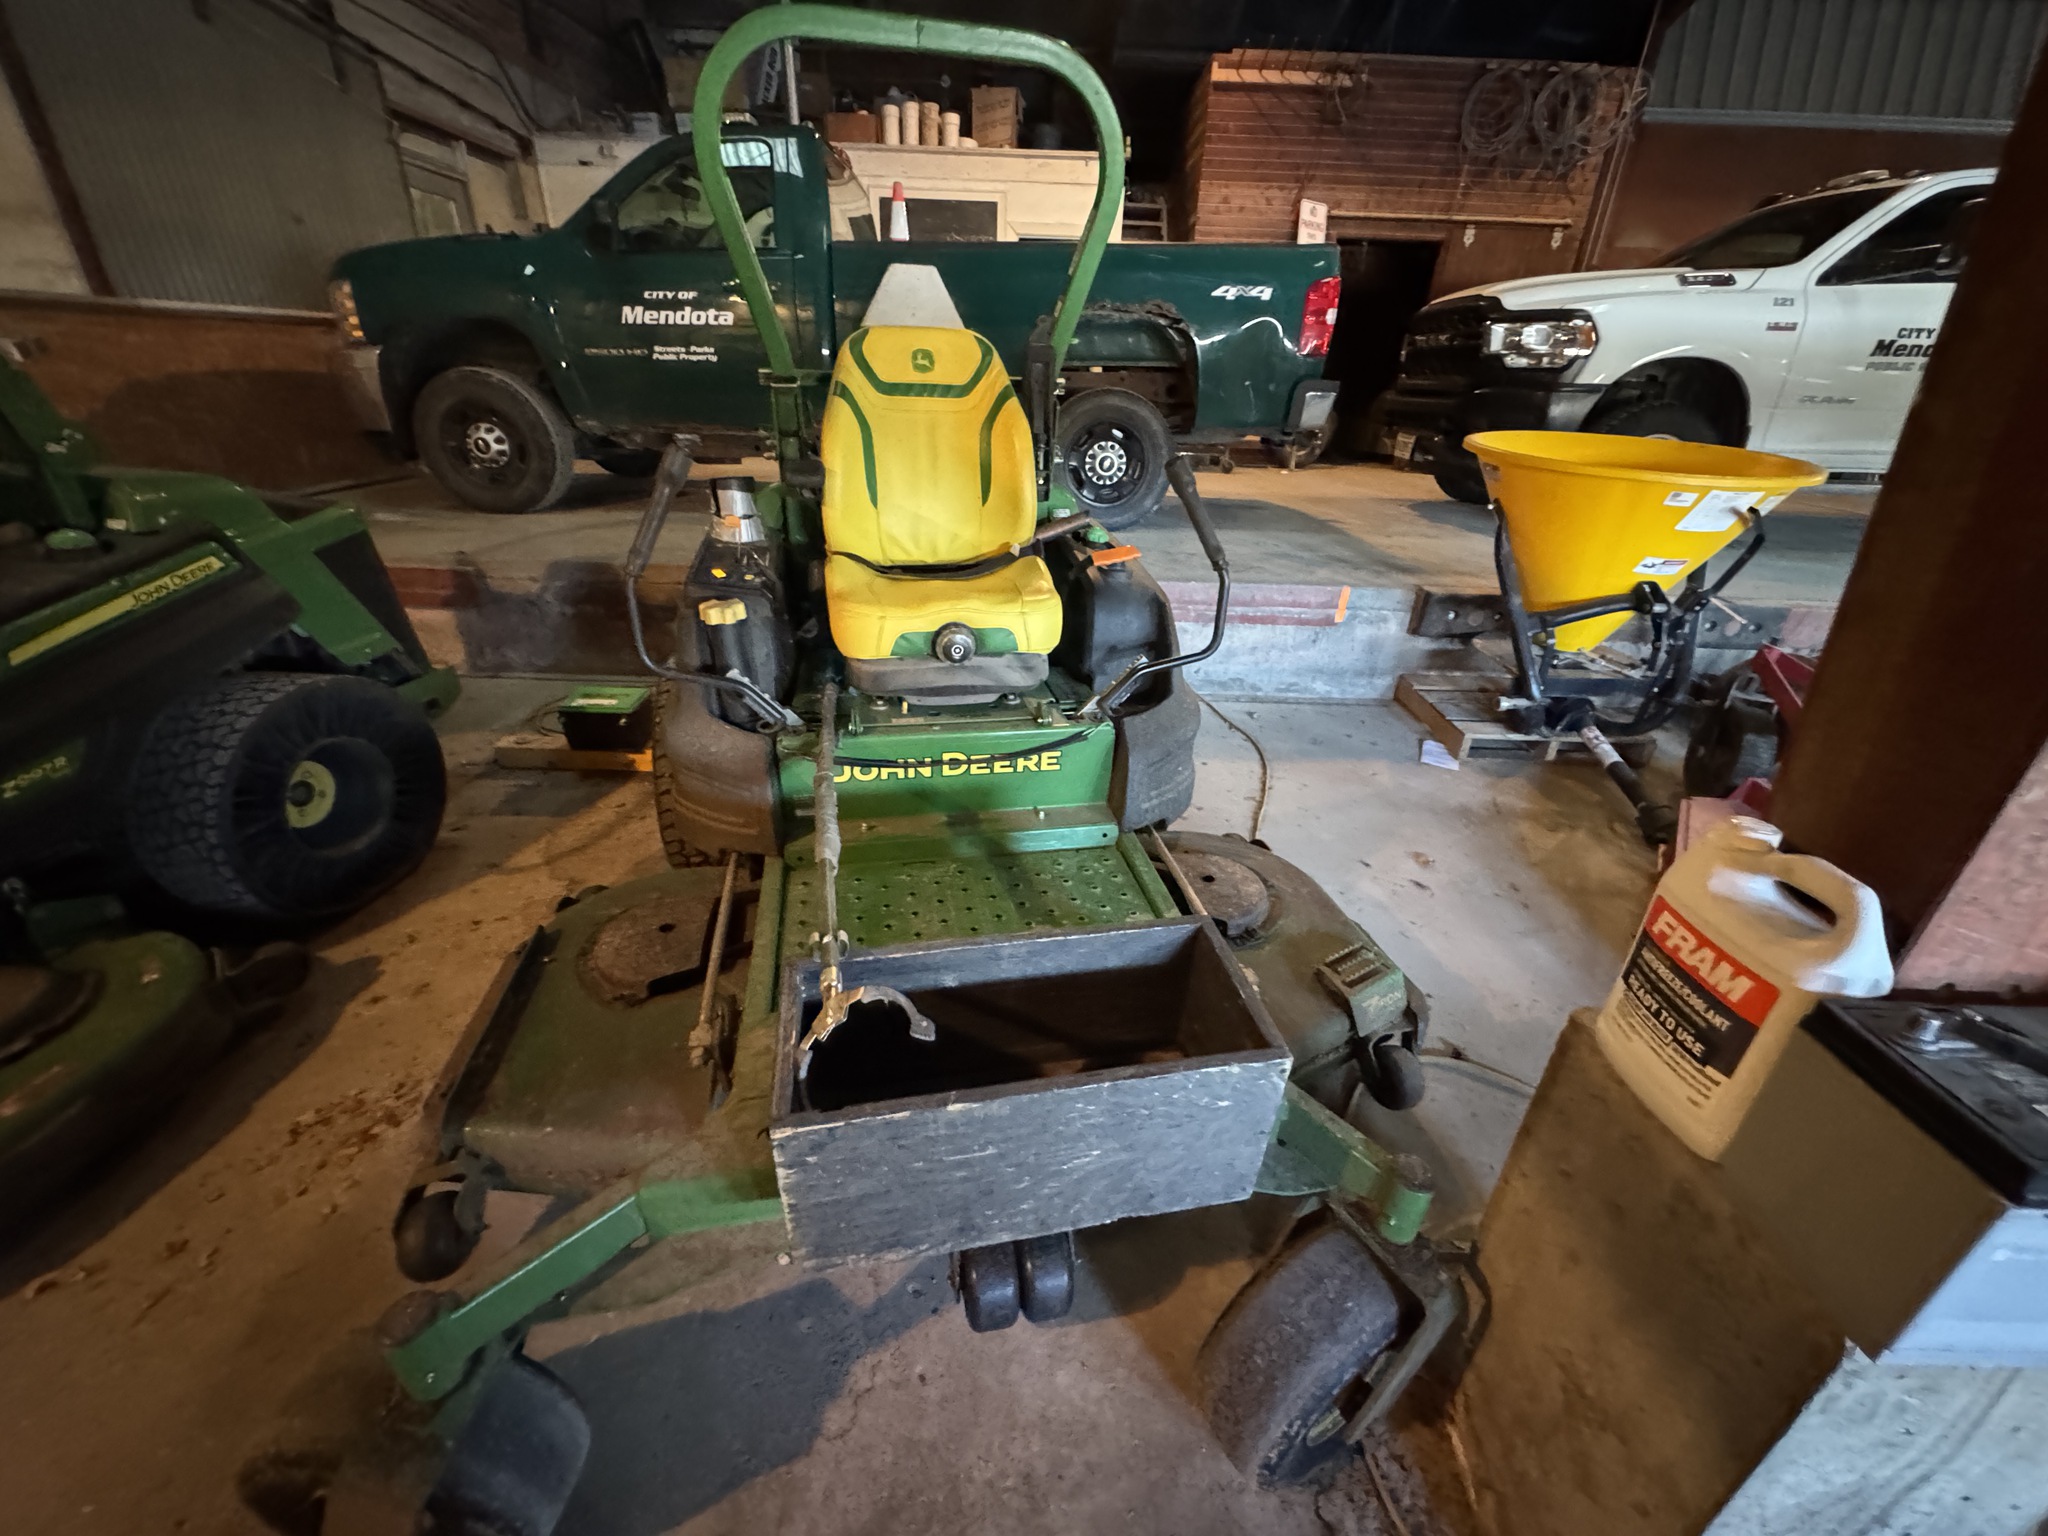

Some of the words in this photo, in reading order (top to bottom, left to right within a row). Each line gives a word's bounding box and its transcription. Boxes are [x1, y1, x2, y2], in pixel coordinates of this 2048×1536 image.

[643, 290, 676, 300] CITY
[678, 291, 698, 300] OF
[621, 305, 735, 326] Mendota
[1897, 327, 1936, 339] CITY
[652, 352, 678, 361] Public
[680, 353, 718, 362] Property
[132, 583, 170, 607] JOHN
[172, 561, 214, 587] DEERE
[833, 758, 932, 783] JOHN
[942, 751, 1062, 776] DEERE
[1652, 911, 1756, 1003] FRAM
[1628, 973, 1658, 1010] READY
[1659, 1009, 1677, 1030] TO
[1676, 1027, 1705, 1057] USE
